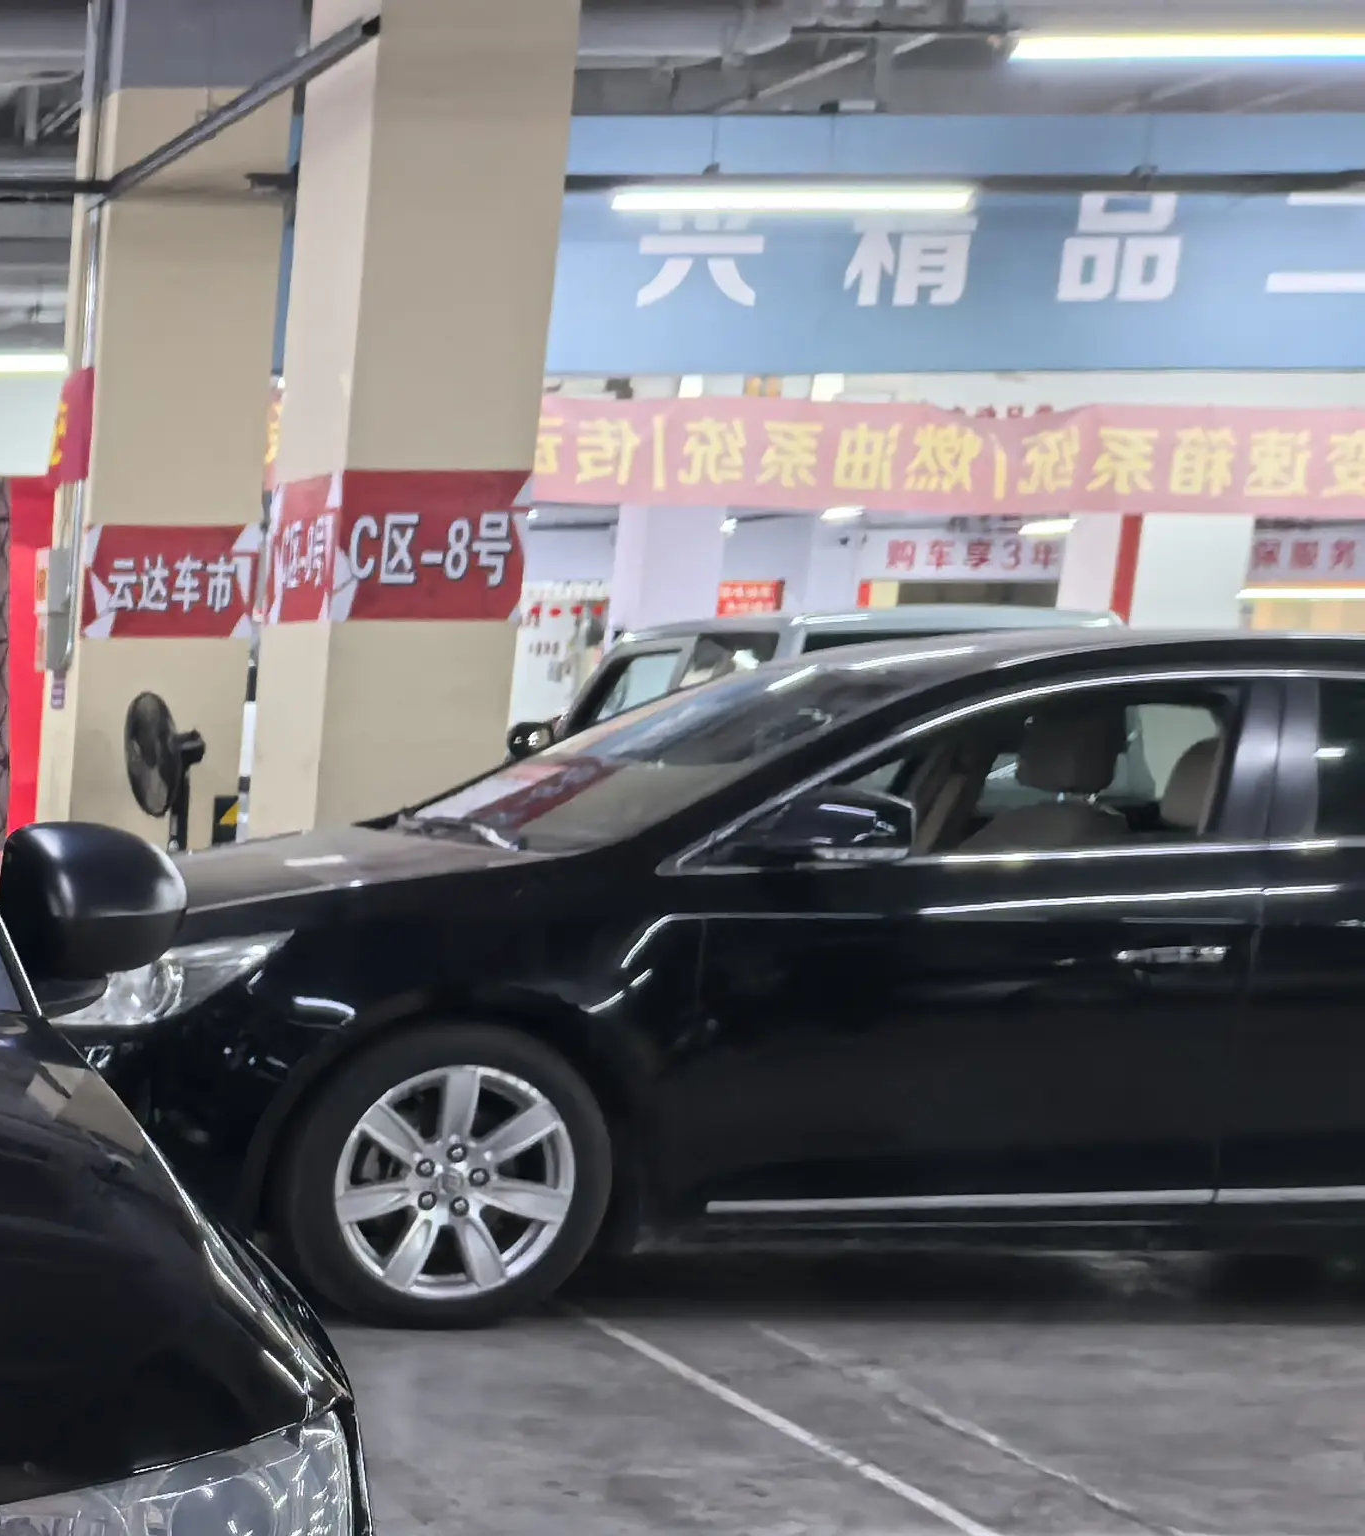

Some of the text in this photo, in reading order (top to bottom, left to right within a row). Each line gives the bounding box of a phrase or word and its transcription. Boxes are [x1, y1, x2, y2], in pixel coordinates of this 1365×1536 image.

[107, 552, 238, 613] 云达车市
[349, 510, 512, 588] C区-8号
